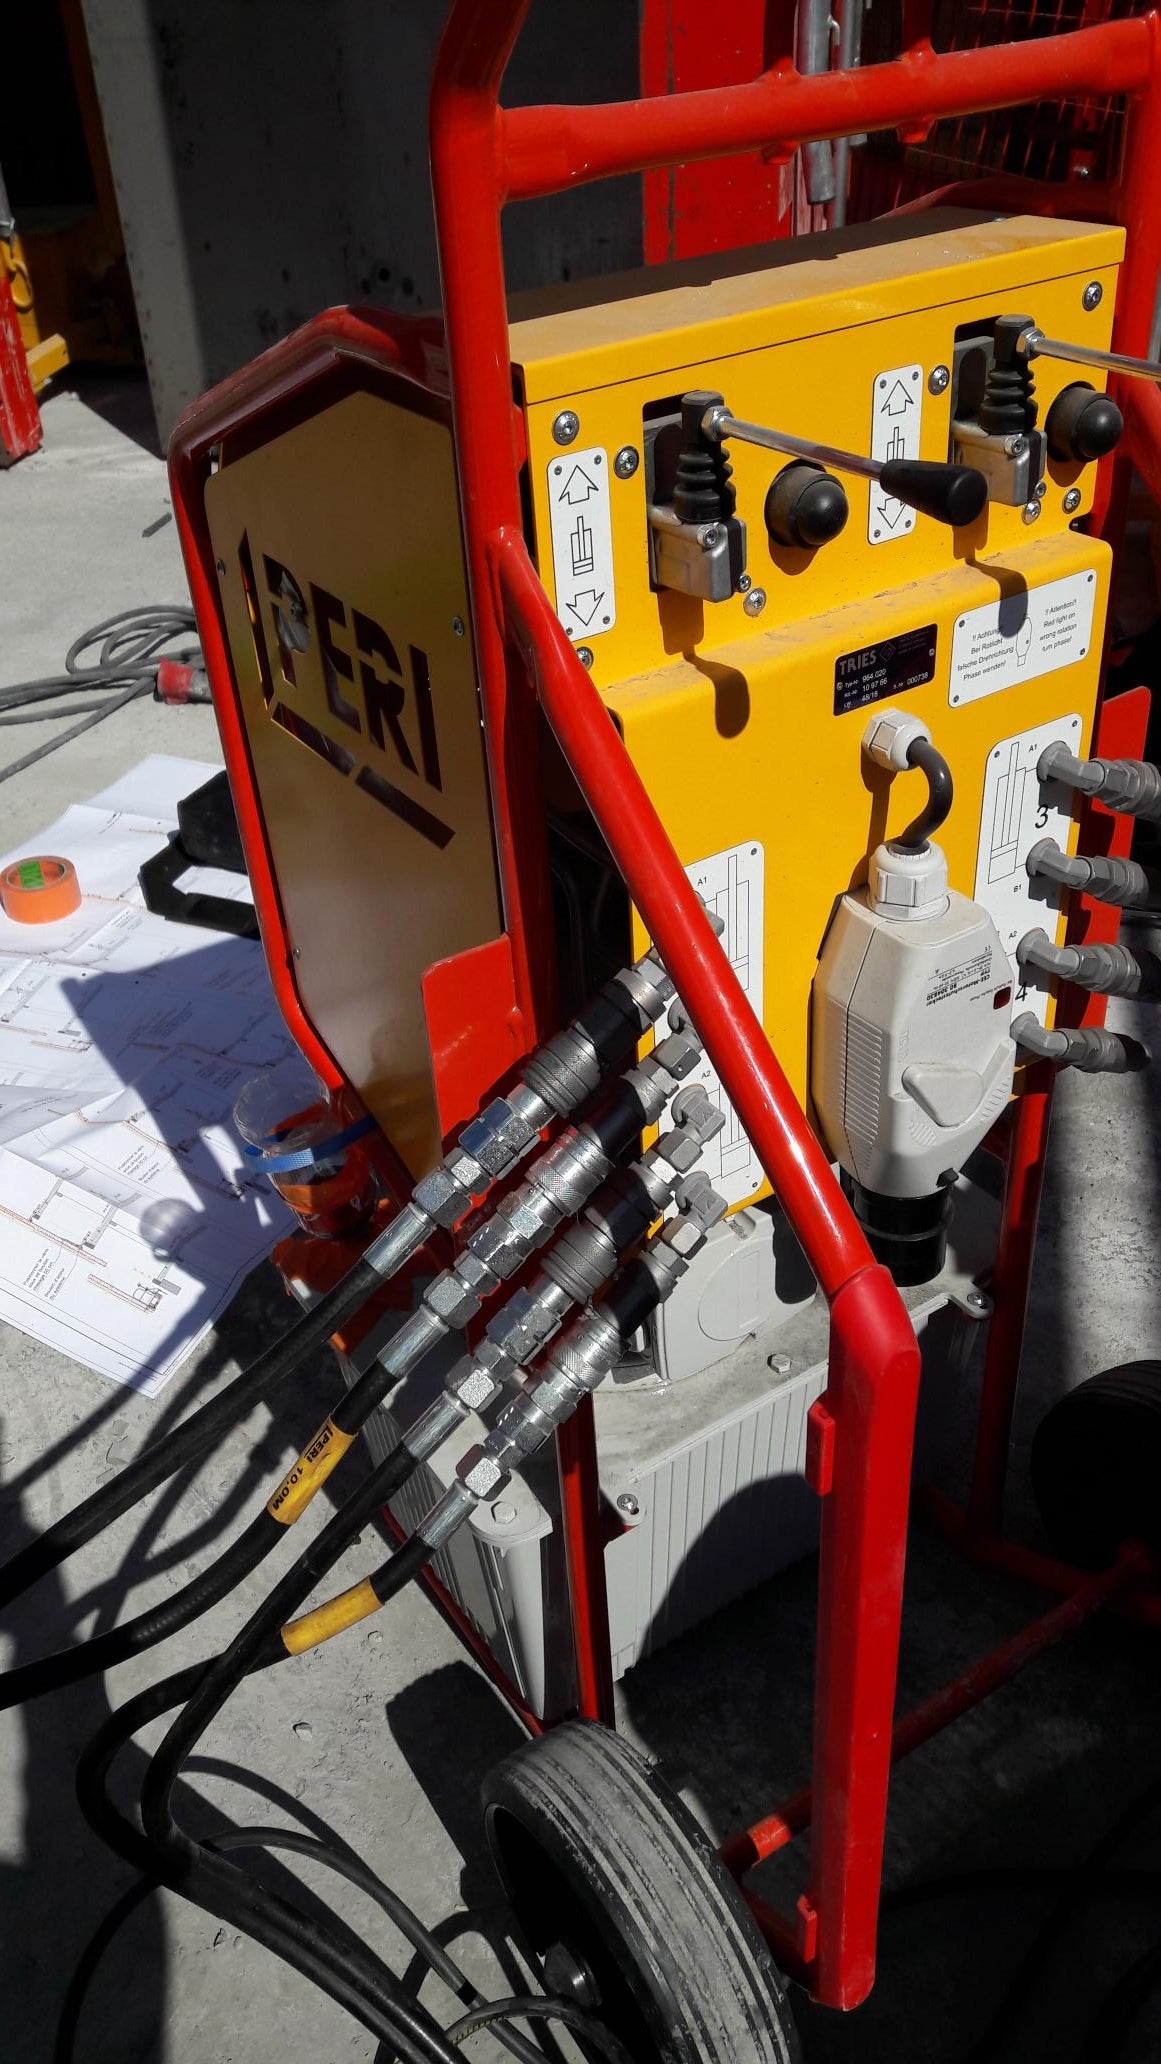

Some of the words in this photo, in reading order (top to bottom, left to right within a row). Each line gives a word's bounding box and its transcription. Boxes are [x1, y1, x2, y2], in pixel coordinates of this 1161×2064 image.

[1043, 618, 1055, 628] Red
[839, 650, 877, 676] TRIES
[262, 553, 443, 793] PERI
[963, 670, 982, 681] Phase
[1028, 744, 1038, 753] A1
[1035, 803, 1049, 829] 3
[697, 876, 707, 886] A1
[1013, 884, 1022, 893] B1
[1008, 930, 1017, 939] A2
[1015, 980, 1028, 1002] 4
[701, 1070, 711, 1080] A2
[306, 1430, 331, 1462] PERI
